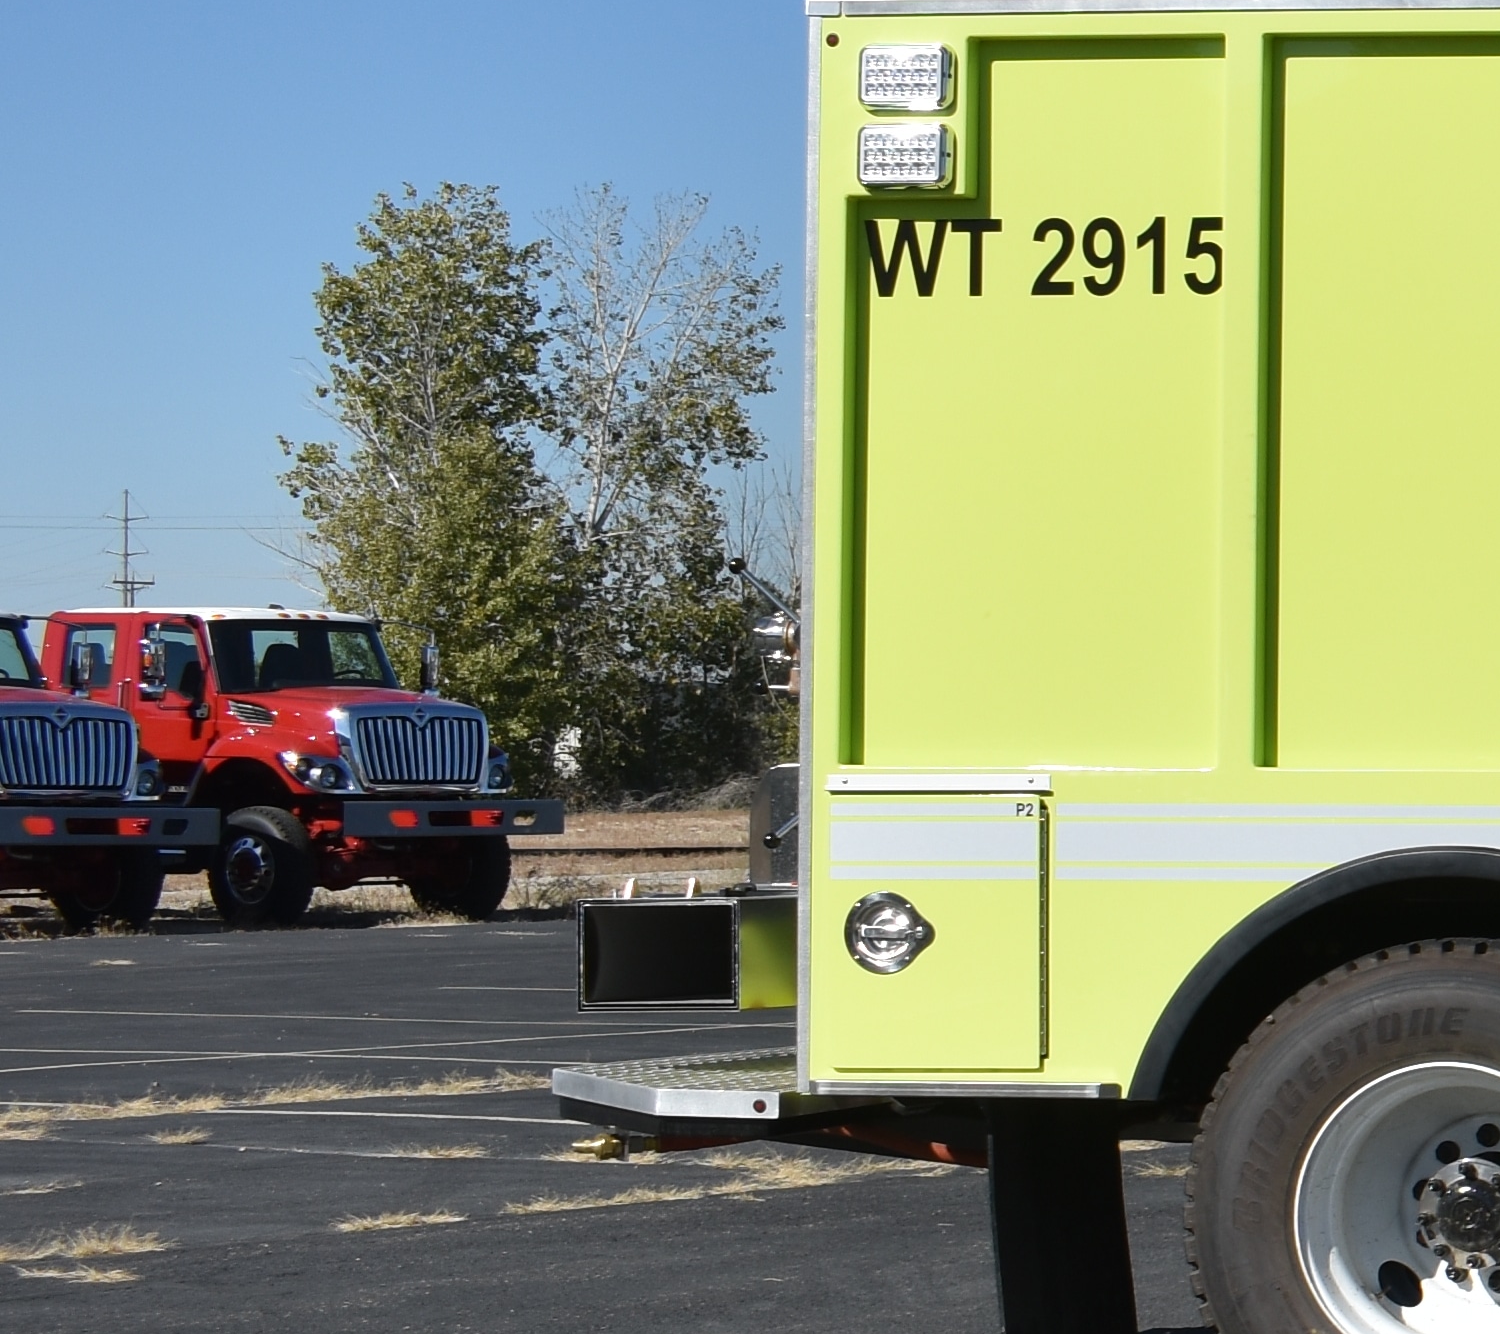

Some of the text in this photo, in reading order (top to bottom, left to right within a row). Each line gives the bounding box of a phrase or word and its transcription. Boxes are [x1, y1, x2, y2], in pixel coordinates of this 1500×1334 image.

[864, 216, 1224, 298] WT 2915
[1016, 802, 1035, 817] P2
[1231, 1007, 1471, 1231] BRIDGESTONE
